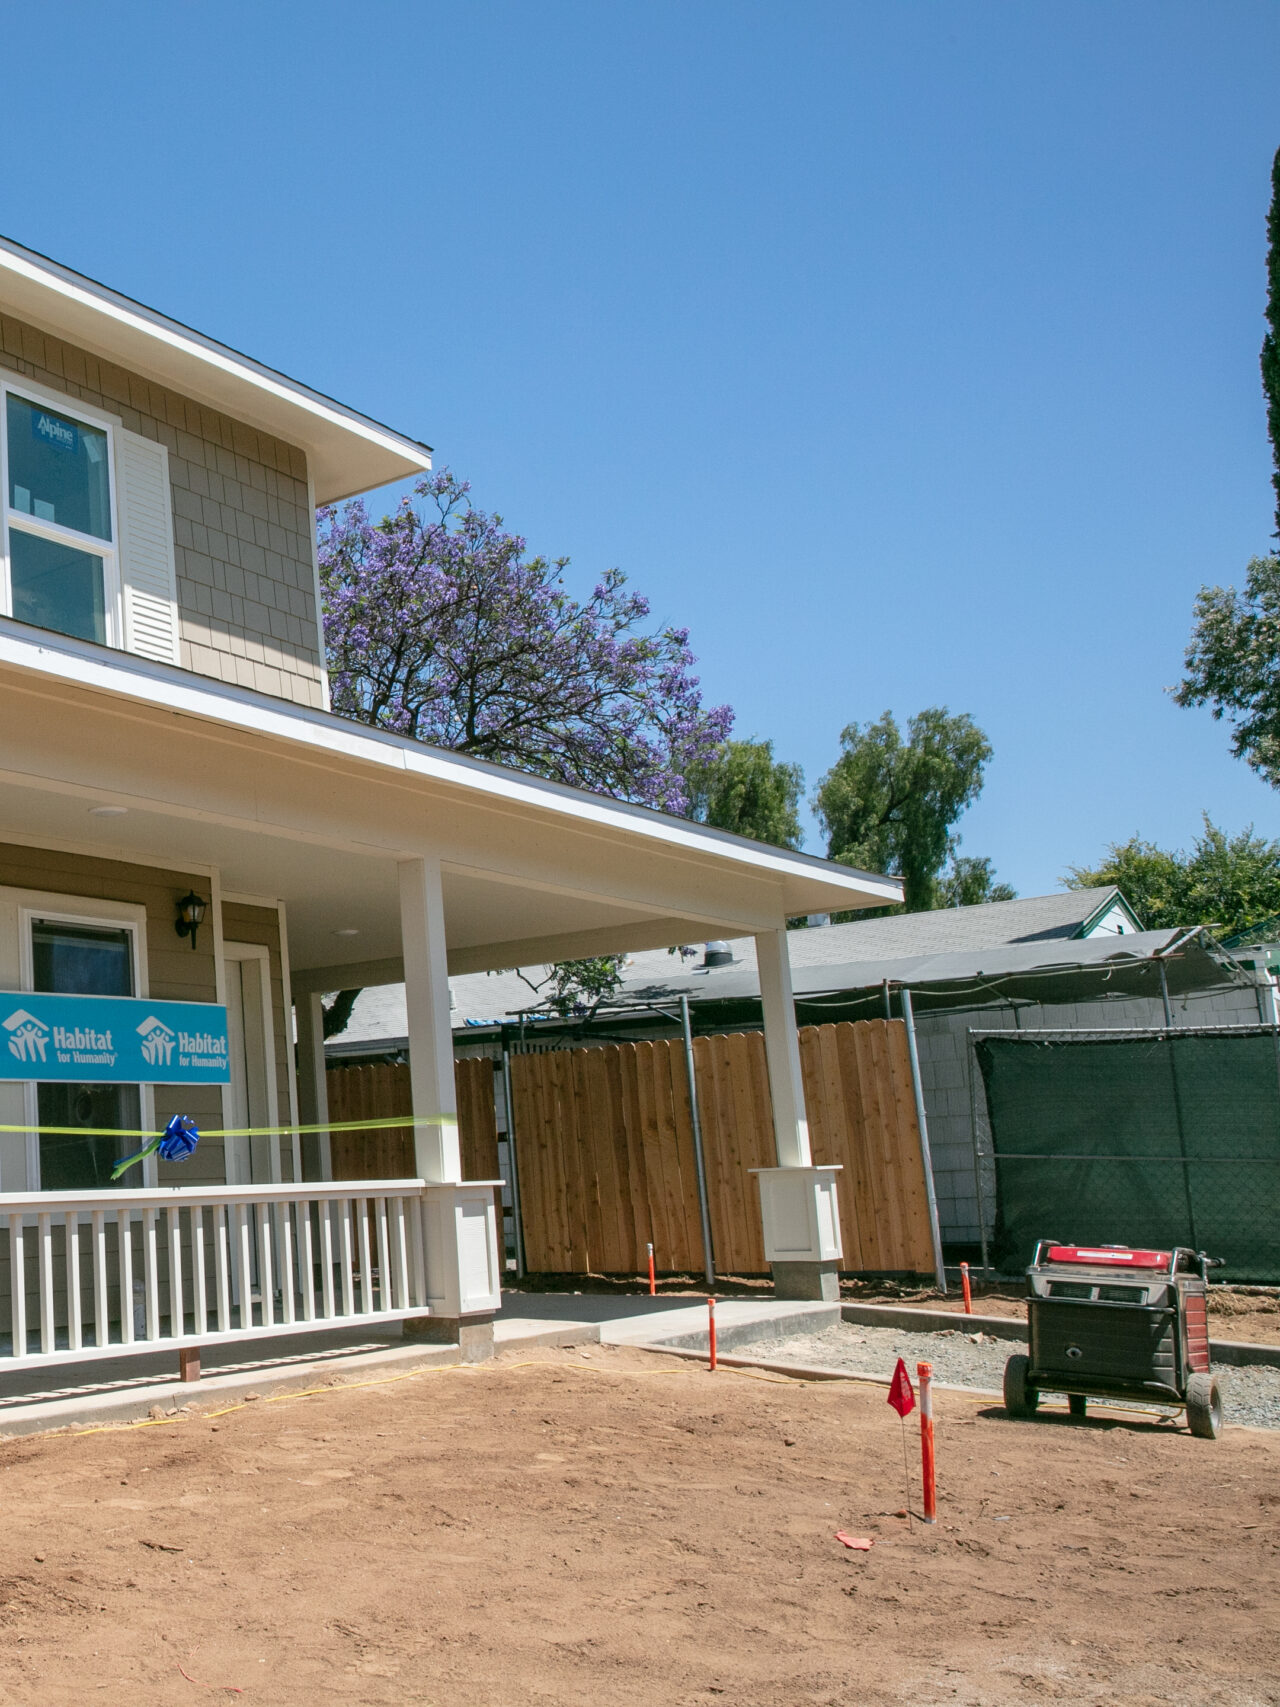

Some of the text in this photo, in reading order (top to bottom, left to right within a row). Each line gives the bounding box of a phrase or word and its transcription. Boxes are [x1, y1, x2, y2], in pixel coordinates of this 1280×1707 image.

[38, 416, 73, 441] Alpine
[53, 1027, 113, 1051] Habitat
[179, 1032, 226, 1054] Habitat
[57, 1050, 116, 1067] for Humanity
[179, 1055, 227, 1071] for Humanity
